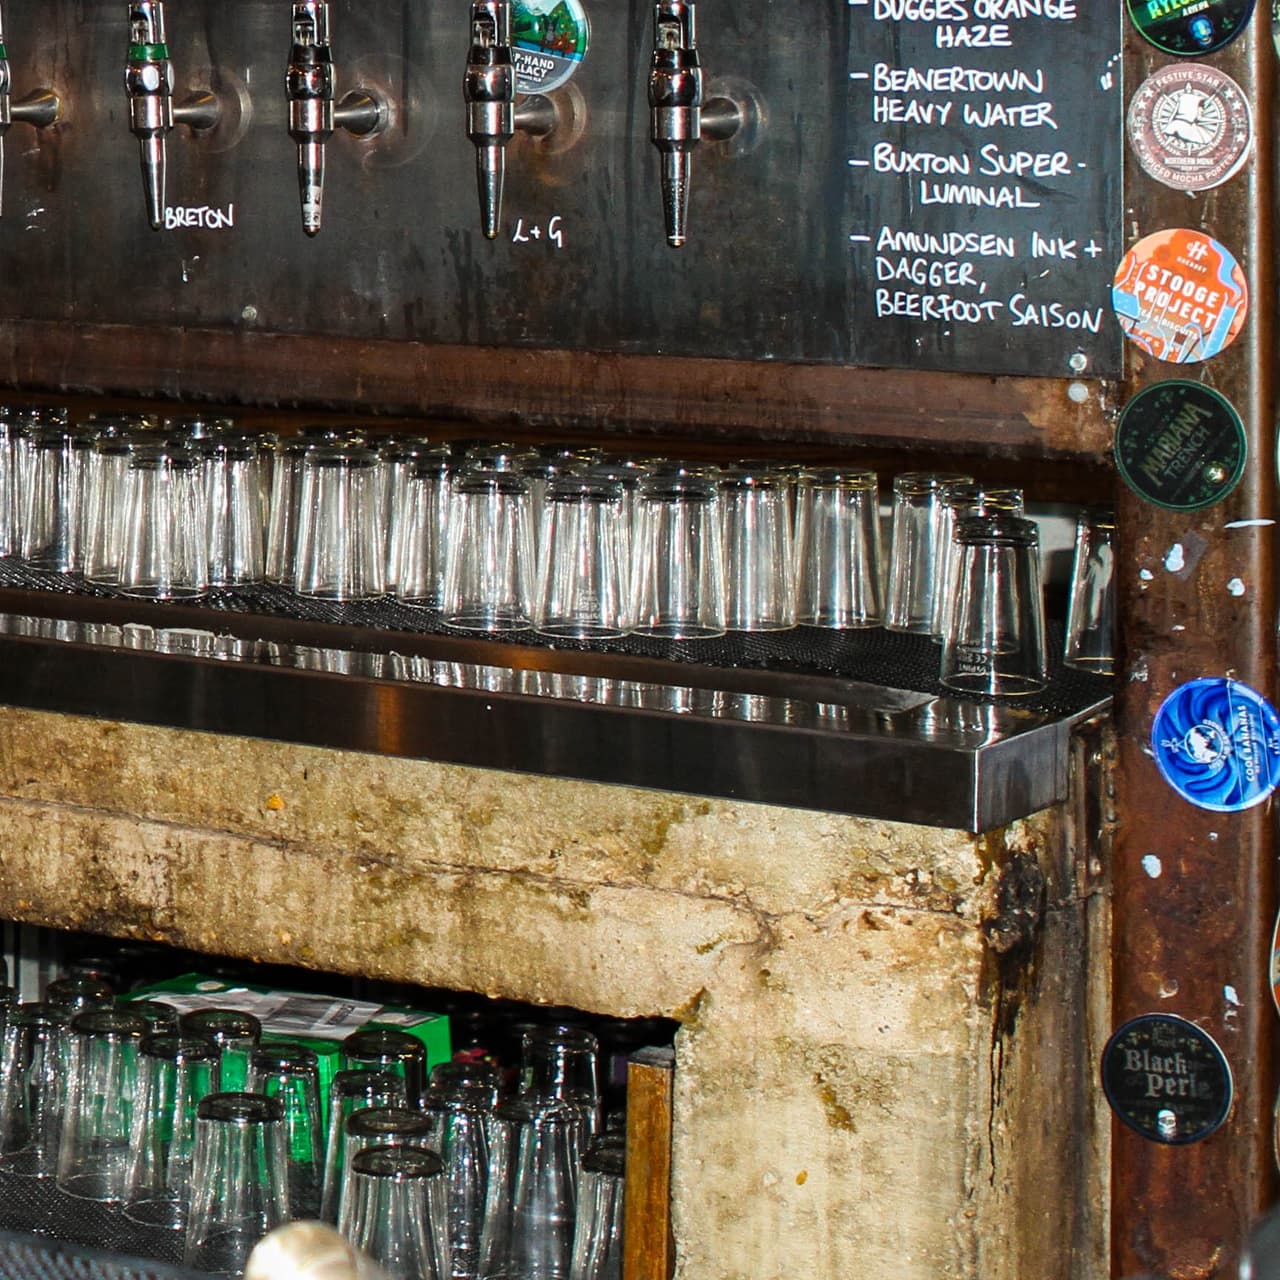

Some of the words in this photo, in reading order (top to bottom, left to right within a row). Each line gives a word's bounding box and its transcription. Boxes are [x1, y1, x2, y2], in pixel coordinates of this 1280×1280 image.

[935, 24, 1013, 49] HAZE
[873, 62, 1044, 94] BEAVERTOWN
[873, 95, 953, 126] HEAVY
[963, 102, 1058, 130] WATER
[873, 142, 971, 175] BUXTON
[920, 180, 1041, 209] LUMINAL
[876, 226, 1015, 258] AMUNDSEN
[1031, 231, 1077, 260] INK
[1146, 264, 1220, 308] STOOGE
[1009, 293, 1104, 333] SAISON
[1136, 281, 1218, 327] PROJECT
